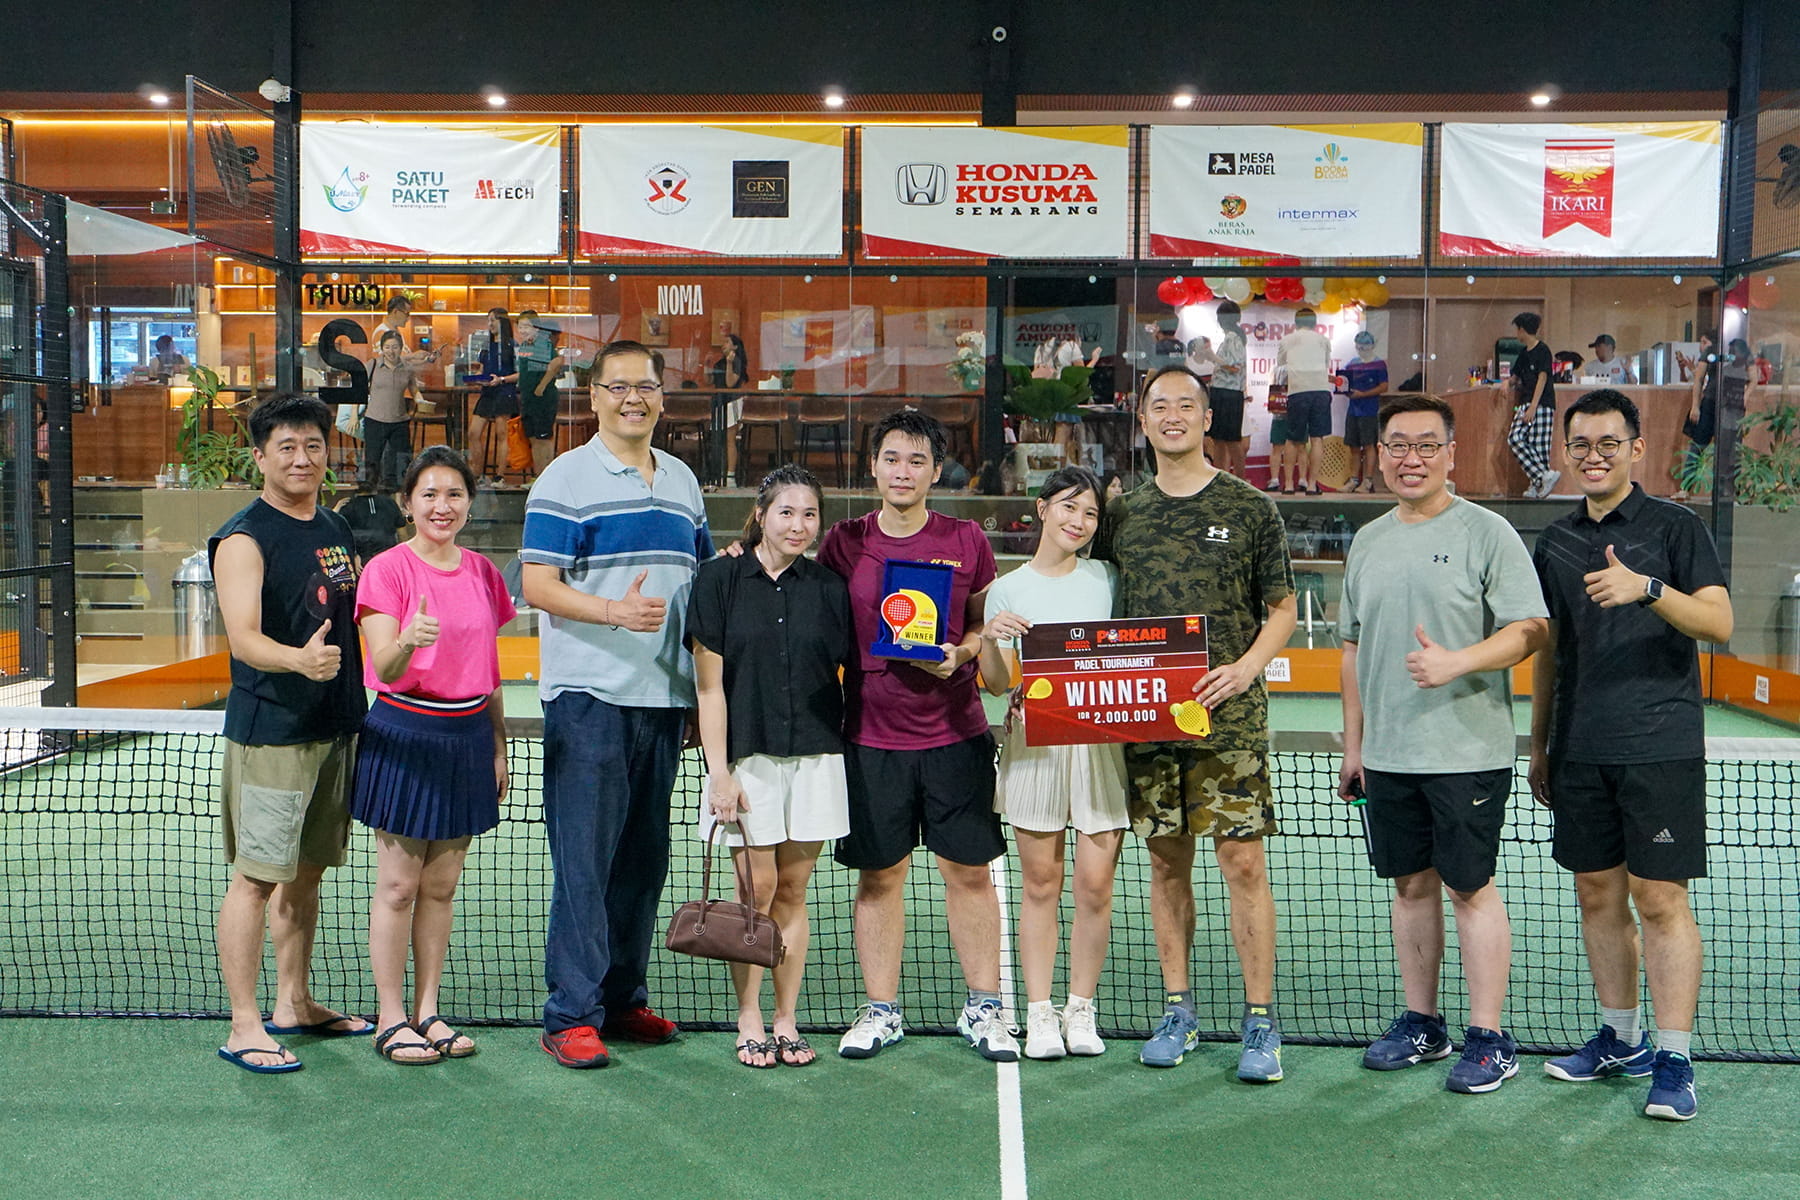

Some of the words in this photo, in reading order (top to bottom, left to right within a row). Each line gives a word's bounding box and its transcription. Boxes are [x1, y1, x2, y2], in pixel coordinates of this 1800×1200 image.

[1240, 152, 1274, 163] MESA
[956, 164, 1098, 182] HONDA
[1238, 165, 1276, 175] PADEL
[396, 171, 444, 187] SATU
[746, 181, 776, 192] GEN
[392, 188, 449, 204] PAKET
[956, 184, 1098, 203] KUSUMA
[1551, 196, 1605, 211] IKARI
[956, 206, 1098, 216] SEMARANG
[1278, 208, 1357, 219] intermax
[1234, 228, 1255, 236] RAJA
[657, 285, 704, 315] NOMA
[905, 631, 933, 641] WINNER
[1074, 659, 1100, 670] PADEL
[1101, 657, 1155, 669] TOURNAMENT
[1267, 661, 1285, 669] ESA
[1266, 669, 1286, 677] ADEL
[1064, 677, 1168, 707] WINNER
[1077, 711, 1091, 720] IDR
[1094, 709, 1157, 724] 2.000.000
